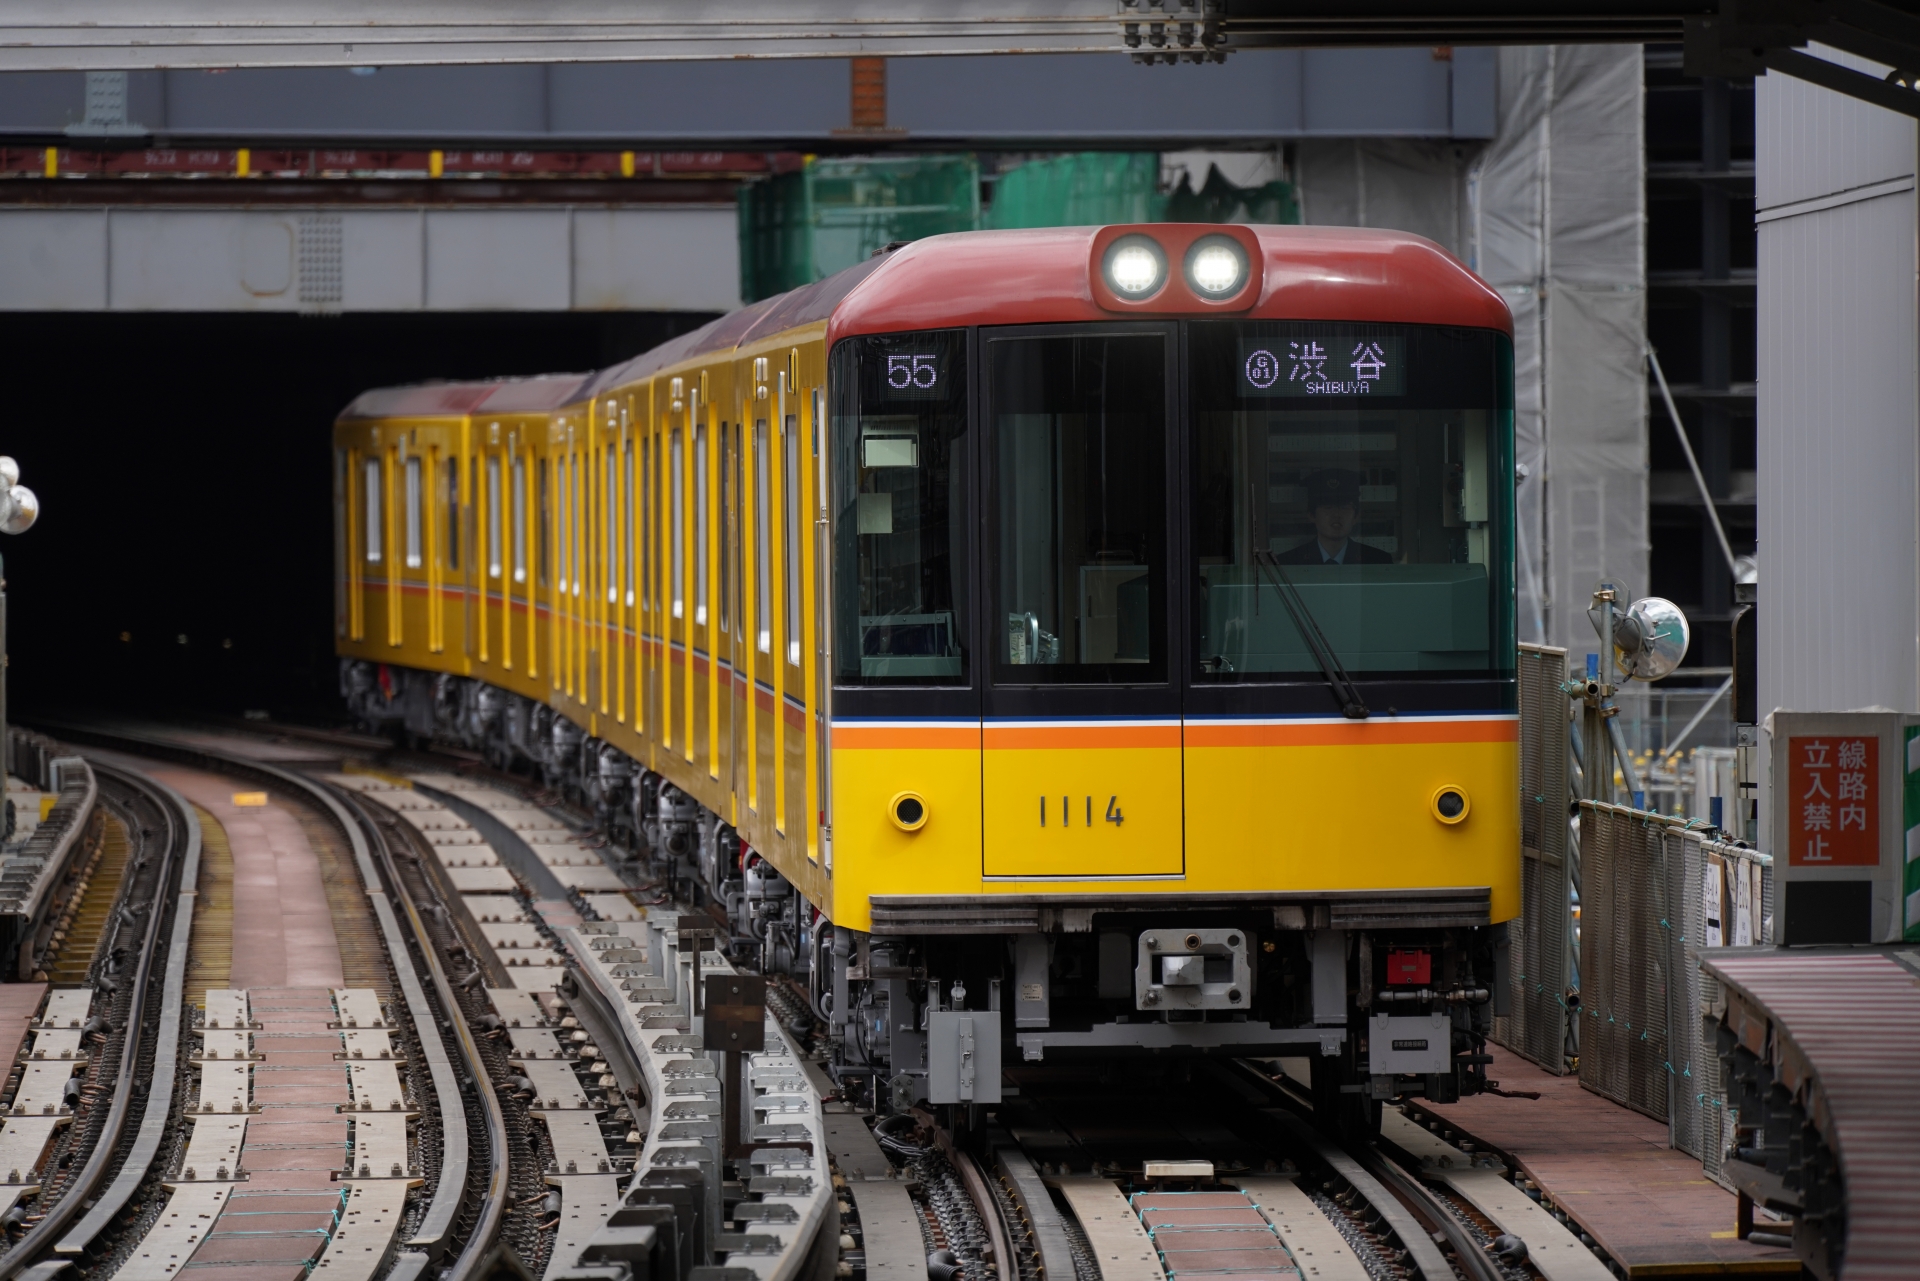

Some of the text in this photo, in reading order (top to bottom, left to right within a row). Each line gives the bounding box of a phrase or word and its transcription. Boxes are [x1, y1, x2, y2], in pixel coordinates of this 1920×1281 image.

[888, 355, 936, 388] 55
[1252, 367, 1270, 378] 01
[1257, 357, 1268, 367] G
[1289, 341, 1387, 381] 渋谷
[1306, 381, 1370, 393] SHIBUYA
[1802, 740, 1832, 861] 立入禁止
[1838, 740, 1868, 831] 線路内
[1040, 795, 1124, 827] 1114
